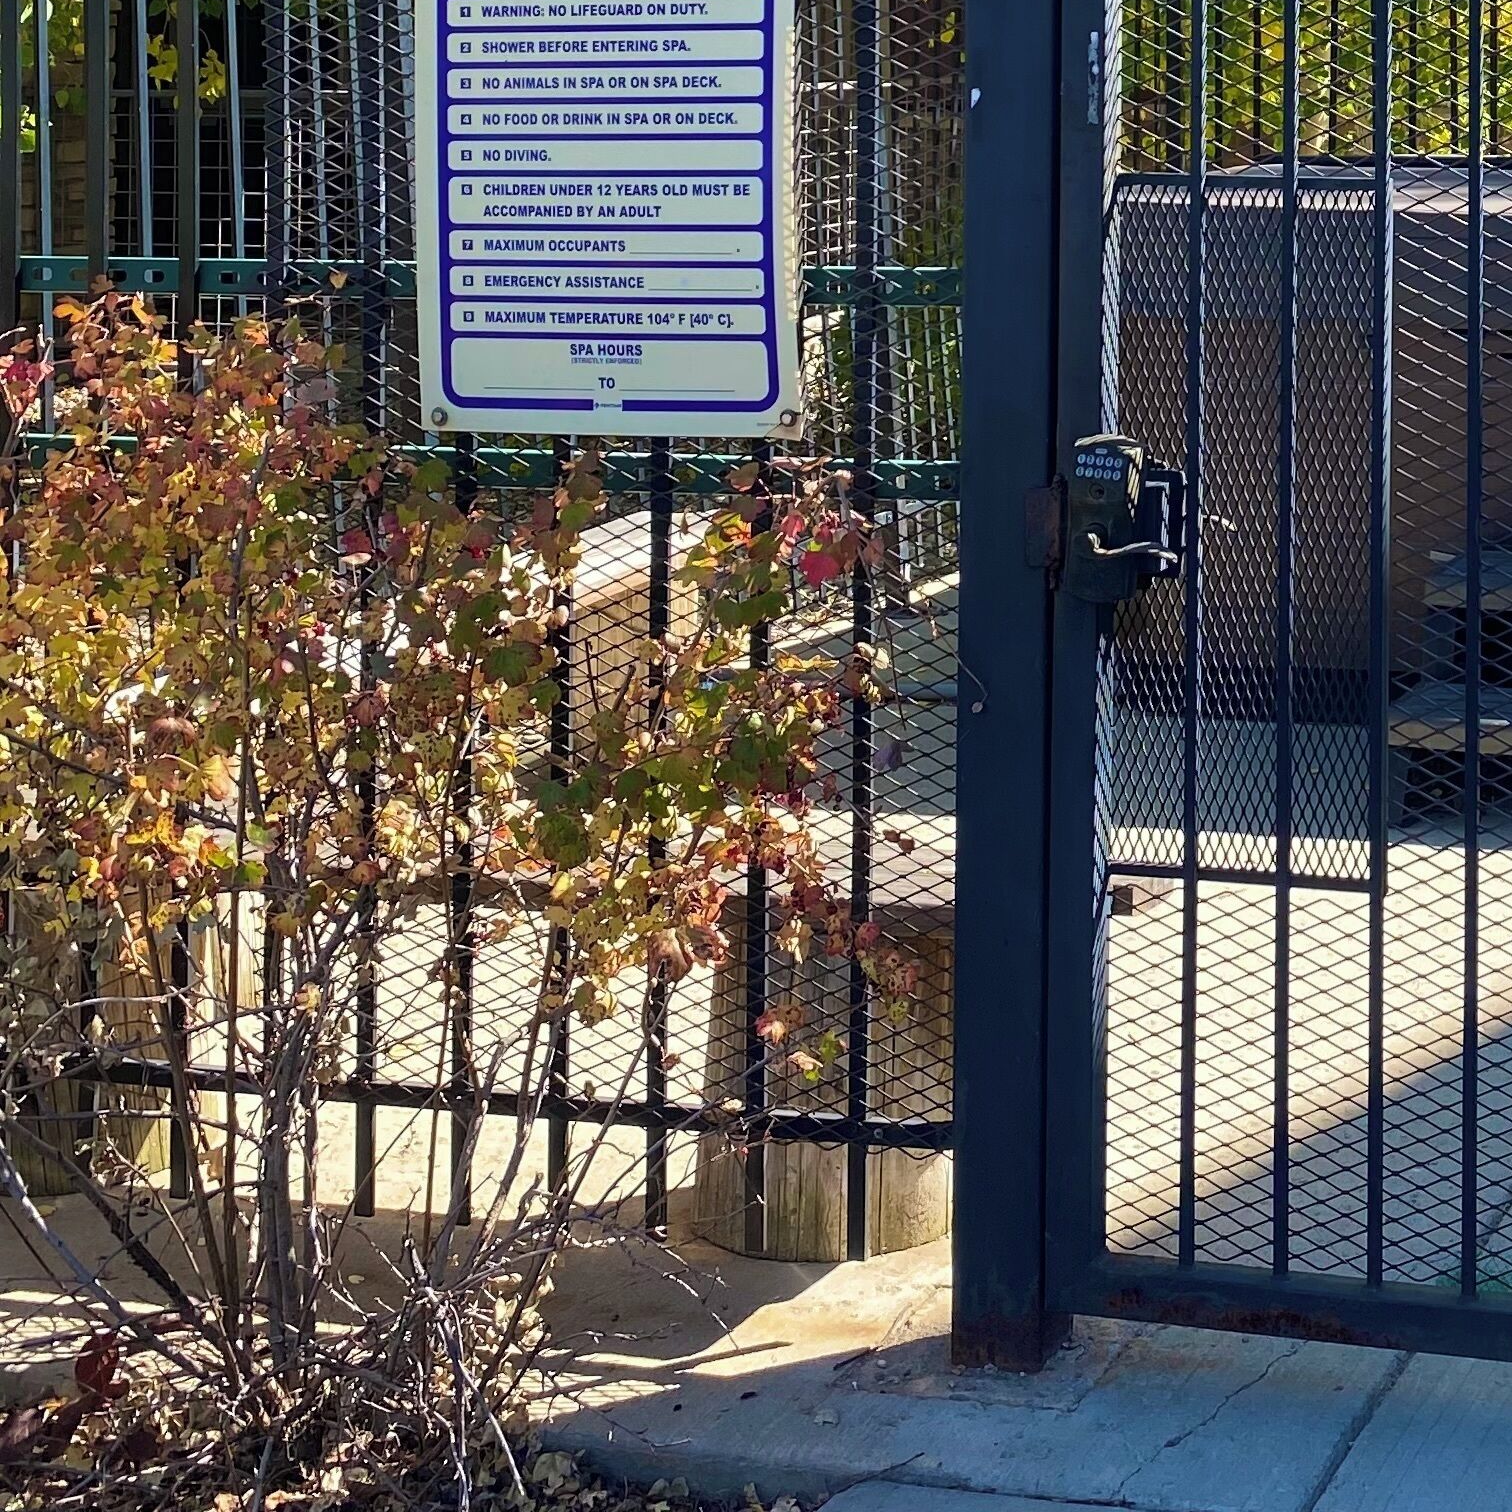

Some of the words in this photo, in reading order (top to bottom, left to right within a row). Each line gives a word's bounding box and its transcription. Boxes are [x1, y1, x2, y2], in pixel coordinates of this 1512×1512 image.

[462, 7, 470, 17] 1
[481, 5, 545, 17] WARNING:
[549, 5, 567, 17] NO
[570, 4, 642, 17] LIFEGUARD
[647, 3, 666, 16] ON
[670, 3, 708, 16] DUTY.
[462, 43, 470, 53] 2
[481, 41, 534, 53] SHOWER
[539, 40, 588, 53] BEFORE
[592, 40, 658, 53] ENTERING
[662, 39, 691, 52] SPA.
[462, 79, 470, 89] 3
[482, 77, 500, 89] NO
[504, 76, 560, 89] ANIMALS
[563, 76, 577, 89] IN
[580, 76, 604, 89] SPA
[608, 76, 626, 88] OR
[631, 76, 650, 88] ON
[653, 76, 678, 88] SPA
[683, 75, 722, 88] DECK.
[462, 115, 470, 125] 4
[482, 113, 500, 126] NO
[504, 113, 538, 126] FOOD
[542, 113, 559, 125] OR
[563, 113, 602, 125] DRINK
[607, 113, 620, 125] IN
[624, 113, 649, 125] SPA
[653, 112, 672, 125] OR
[676, 112, 695, 125] ON
[699, 112, 738, 124] DECK.
[463, 151, 470, 160] 5
[482, 149, 501, 162] NO
[504, 149, 552, 162] DIVING.
[463, 185, 471, 195] 6
[483, 183, 546, 196] CHILDREN
[550, 184, 593, 196] UNDER
[598, 184, 612, 196] 12
[615, 184, 658, 196] YEARS
[662, 184, 689, 196] OLD
[692, 184, 729, 197] MUST
[733, 184, 751, 197] BE
[483, 205, 573, 218] ACCOMPANIED
[577, 205, 595, 218] BY
[598, 205, 616, 218] AN
[619, 205, 661, 218] ADULT
[464, 241, 471, 250] 7
[484, 239, 545, 252] MAXIMUM
[548, 240, 626, 252] OCCUPANTS
[485, 275, 561, 288] EMERGENCY
[565, 276, 644, 288] ASSISTANCE
[485, 311, 545, 324] MAXIMUM
[550, 312, 643, 325] TEMPERATURE
[678, 313, 685, 326] F
[717, 314, 734, 328] C].
[570, 344, 594, 356] SPA
[598, 344, 643, 357] HOURS
[598, 377, 615, 389] TO
